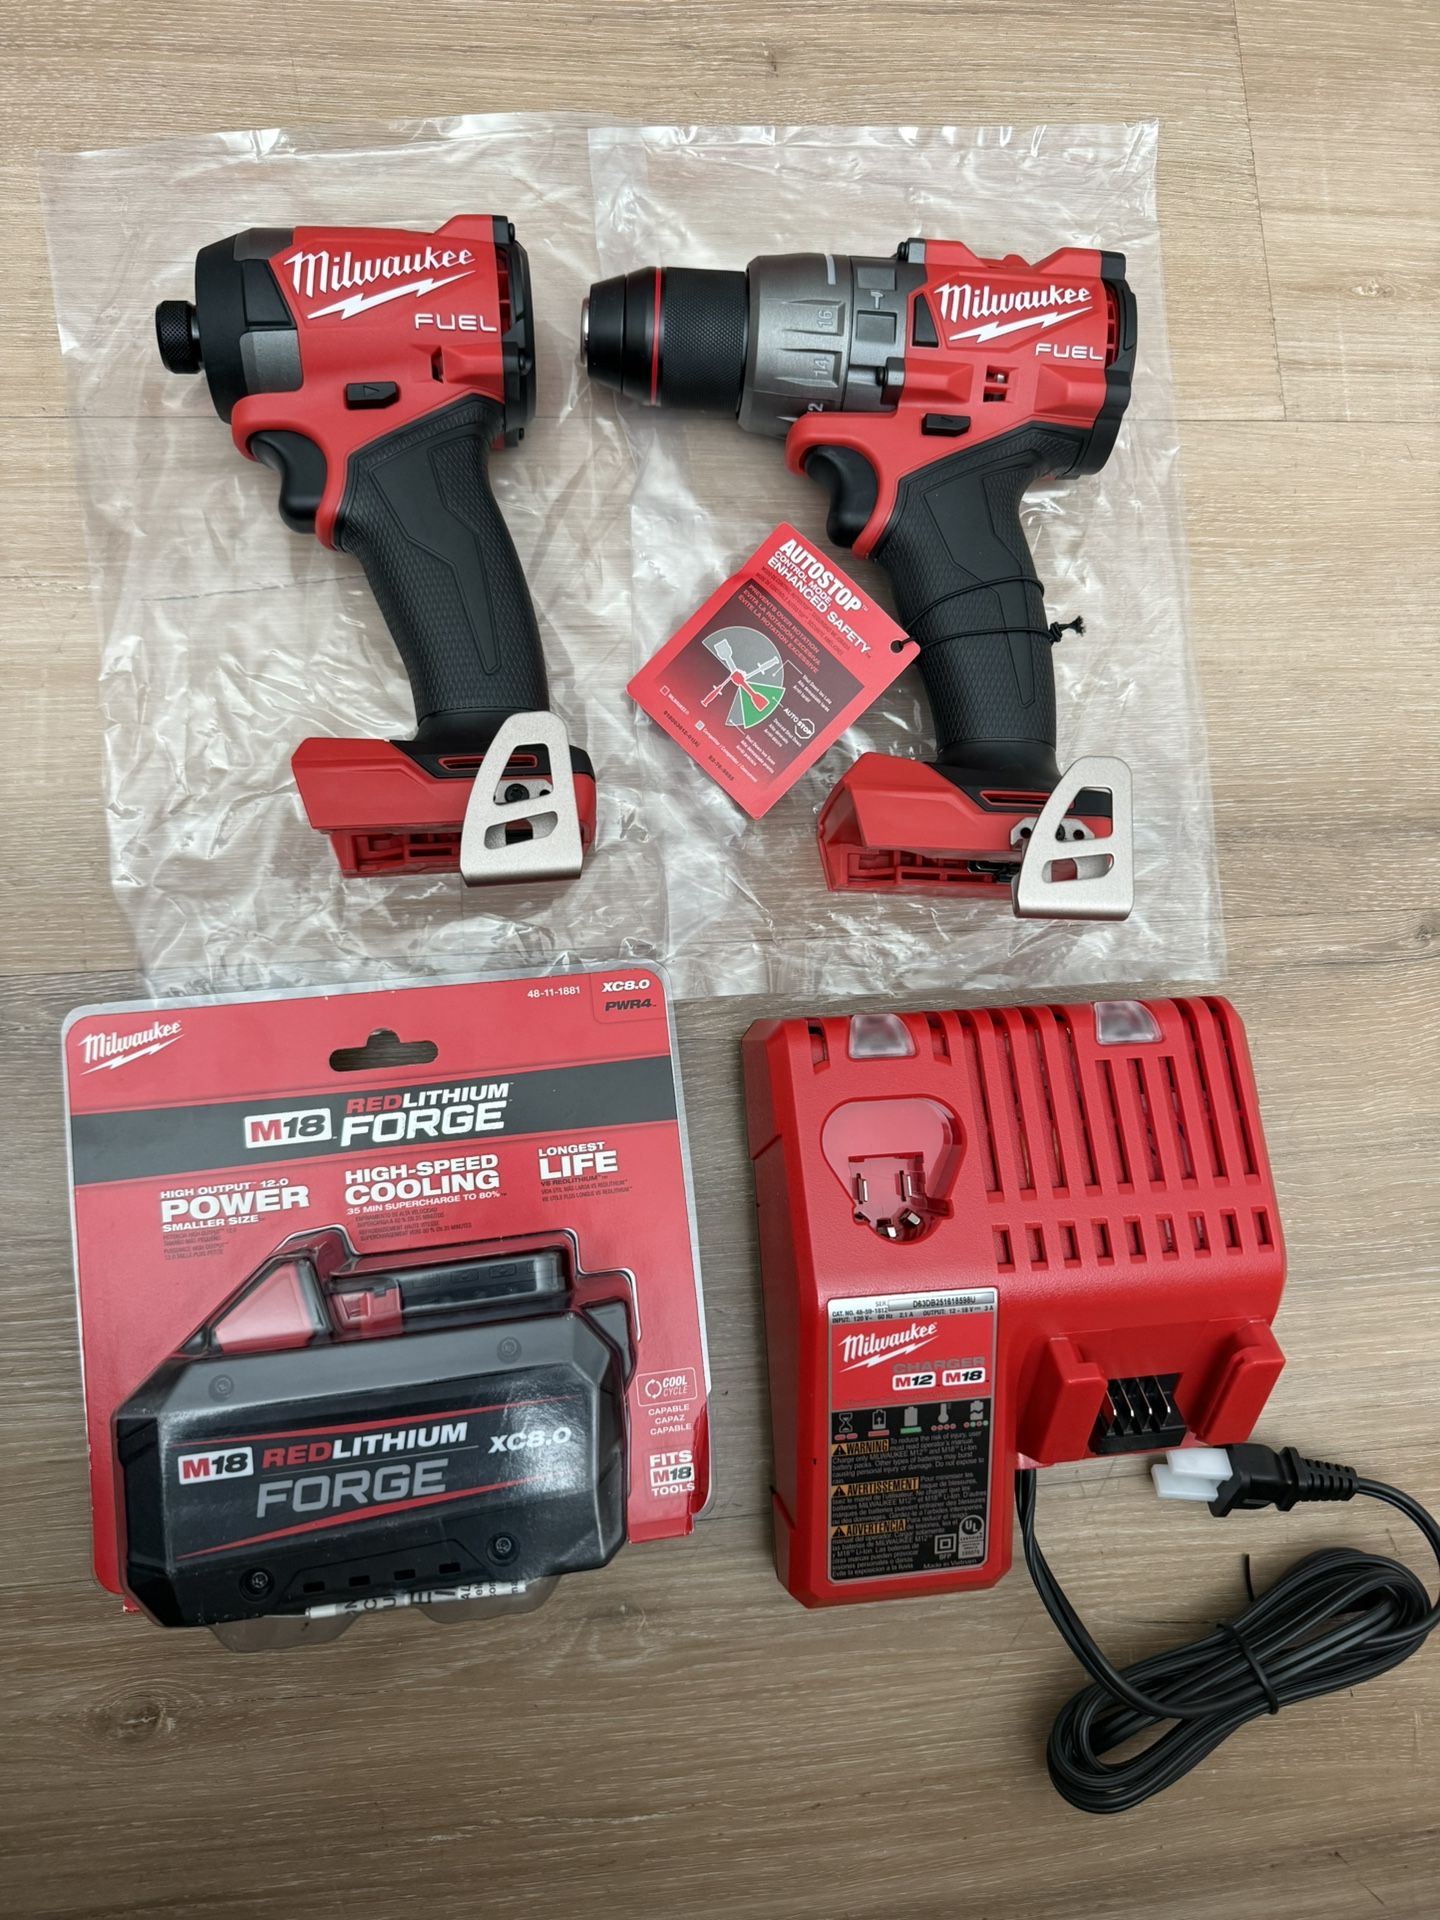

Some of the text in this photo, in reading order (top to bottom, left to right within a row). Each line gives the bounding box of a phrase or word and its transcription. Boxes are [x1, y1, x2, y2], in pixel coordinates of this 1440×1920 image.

[284, 246, 475, 298] Milwaukee
[934, 283, 1093, 323] Milwaukee
[414, 313, 498, 332] FUEL
[1035, 343, 1103, 360] FUEL
[774, 550, 807, 583] CONTROL
[808, 580, 832, 606] MODE,
[767, 556, 828, 613] ENHANCED
[826, 611, 871, 653] SAFETY
[743, 589, 759, 606] EVITA
[758, 603, 766, 613] LA
[793, 638, 820, 665] EXCESIVA
[748, 584, 777, 613] PREVENTS
[776, 610, 793, 627] OVER
[791, 625, 820, 653] ROTATION
[753, 608, 761, 618] LA
[760, 616, 789, 644] ROTATION
[787, 642, 819, 674] EXCESSIVE
[783, 707, 799, 723] AUTO
[796, 720, 813, 736] STOP
[527, 985, 581, 998] 48-11-1881
[601, 979, 650, 992] XC8.0
[79, 1021, 181, 1063] Milwaukee
[345, 1082, 511, 1114] REDLITHIUM
[250, 1100, 507, 1147] M18 FORGE
[538, 1141, 605, 1157] LONGEST
[345, 1154, 498, 1184] HIGH-SPEED
[539, 1150, 618, 1179] LIFE
[160, 1178, 289, 1199] HIGH OUTPUT 12.0
[345, 1169, 499, 1205] COOLING
[160, 1185, 309, 1223] POWER
[347, 1207, 360, 1215] 35
[362, 1204, 383, 1213] MIN
[384, 1194, 460, 1210] SUPERCHARGE
[479, 1190, 500, 1199] 80%
[162, 1214, 258, 1232] SMALLER SIZE
[838, 1322, 938, 1362] Milwaukee
[894, 1357, 984, 1373] CHARGER
[662, 1375, 687, 1388] COOL
[895, 1370, 982, 1387] M12 M18
[663, 1384, 688, 1397] CYCLE
[648, 1403, 689, 1416] CAPABLE
[654, 1414, 685, 1425] CAPAZ
[650, 1422, 691, 1435] CAPABLE
[183, 1422, 573, 1479] M18 REDLITHIUM XC8.0
[846, 1439, 889, 1455] WARNING
[649, 1449, 693, 1467] FITS
[653, 1466, 692, 1483] M18
[256, 1458, 452, 1518] FORGE
[651, 1482, 694, 1496] TOOLS
[846, 1477, 917, 1496] AVERTISSEMENT
[845, 1519, 905, 1536] ADVERTENCIA
[965, 1519, 978, 1532] UL
